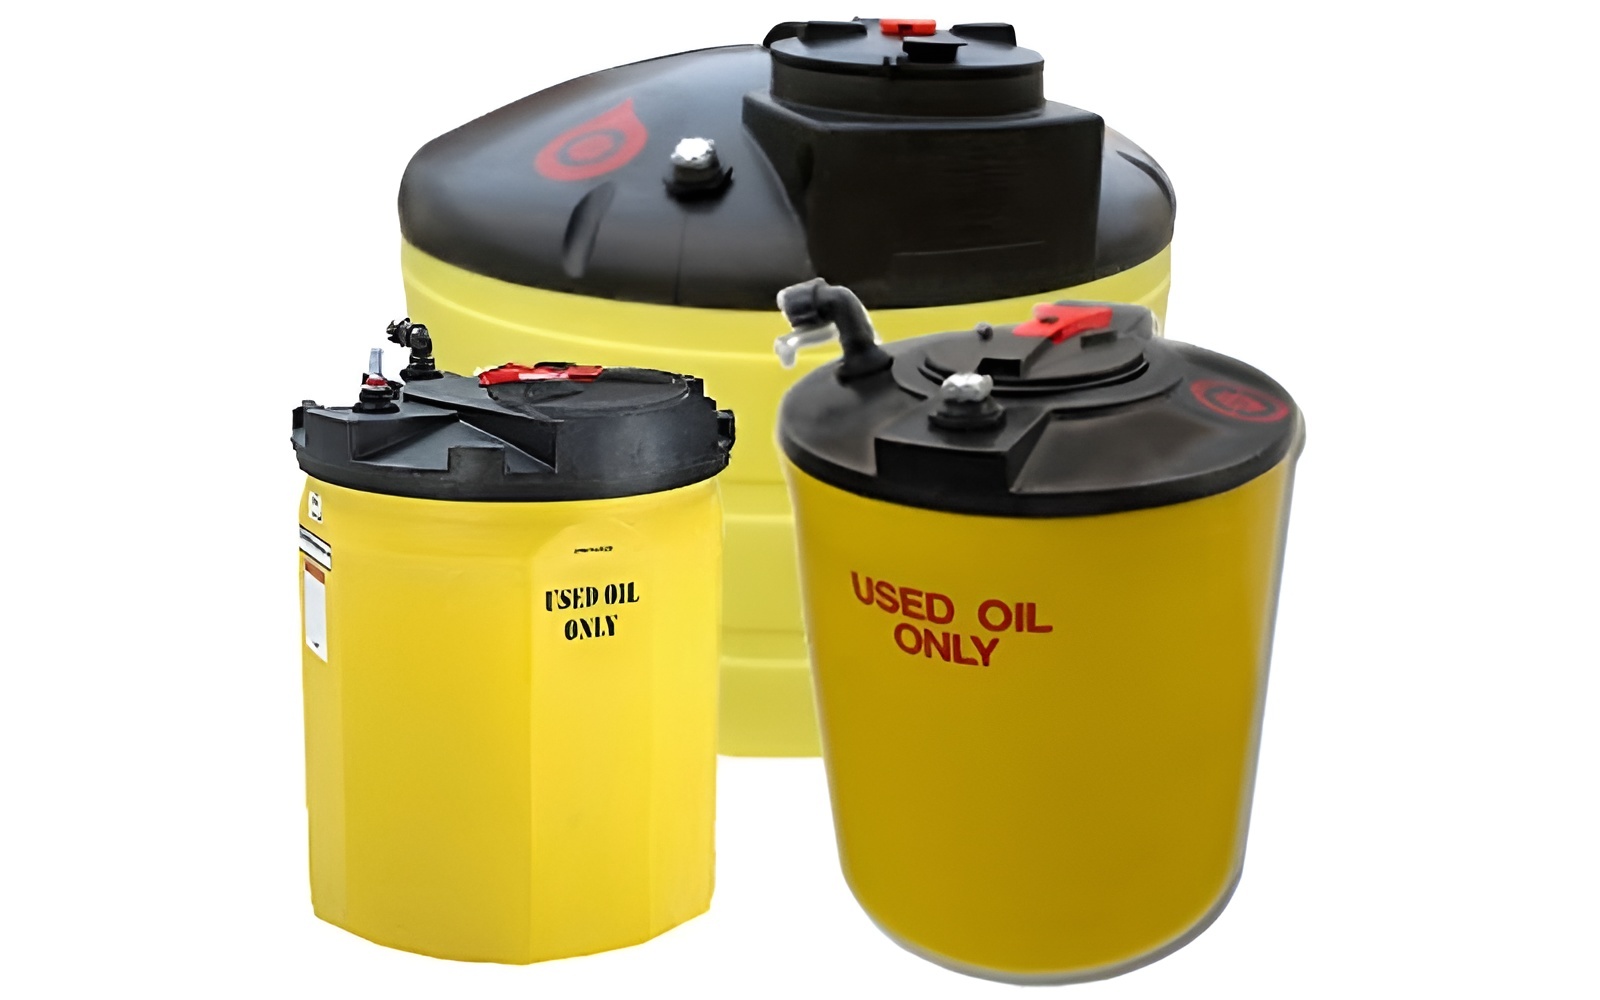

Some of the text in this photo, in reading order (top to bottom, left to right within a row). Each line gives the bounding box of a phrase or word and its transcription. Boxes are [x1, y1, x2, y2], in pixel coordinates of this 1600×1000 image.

[545, 581, 640, 612] USED OIL
[851, 571, 1053, 633] USED OIL
[564, 614, 618, 641] ONLY
[894, 622, 1000, 667] ONLY
